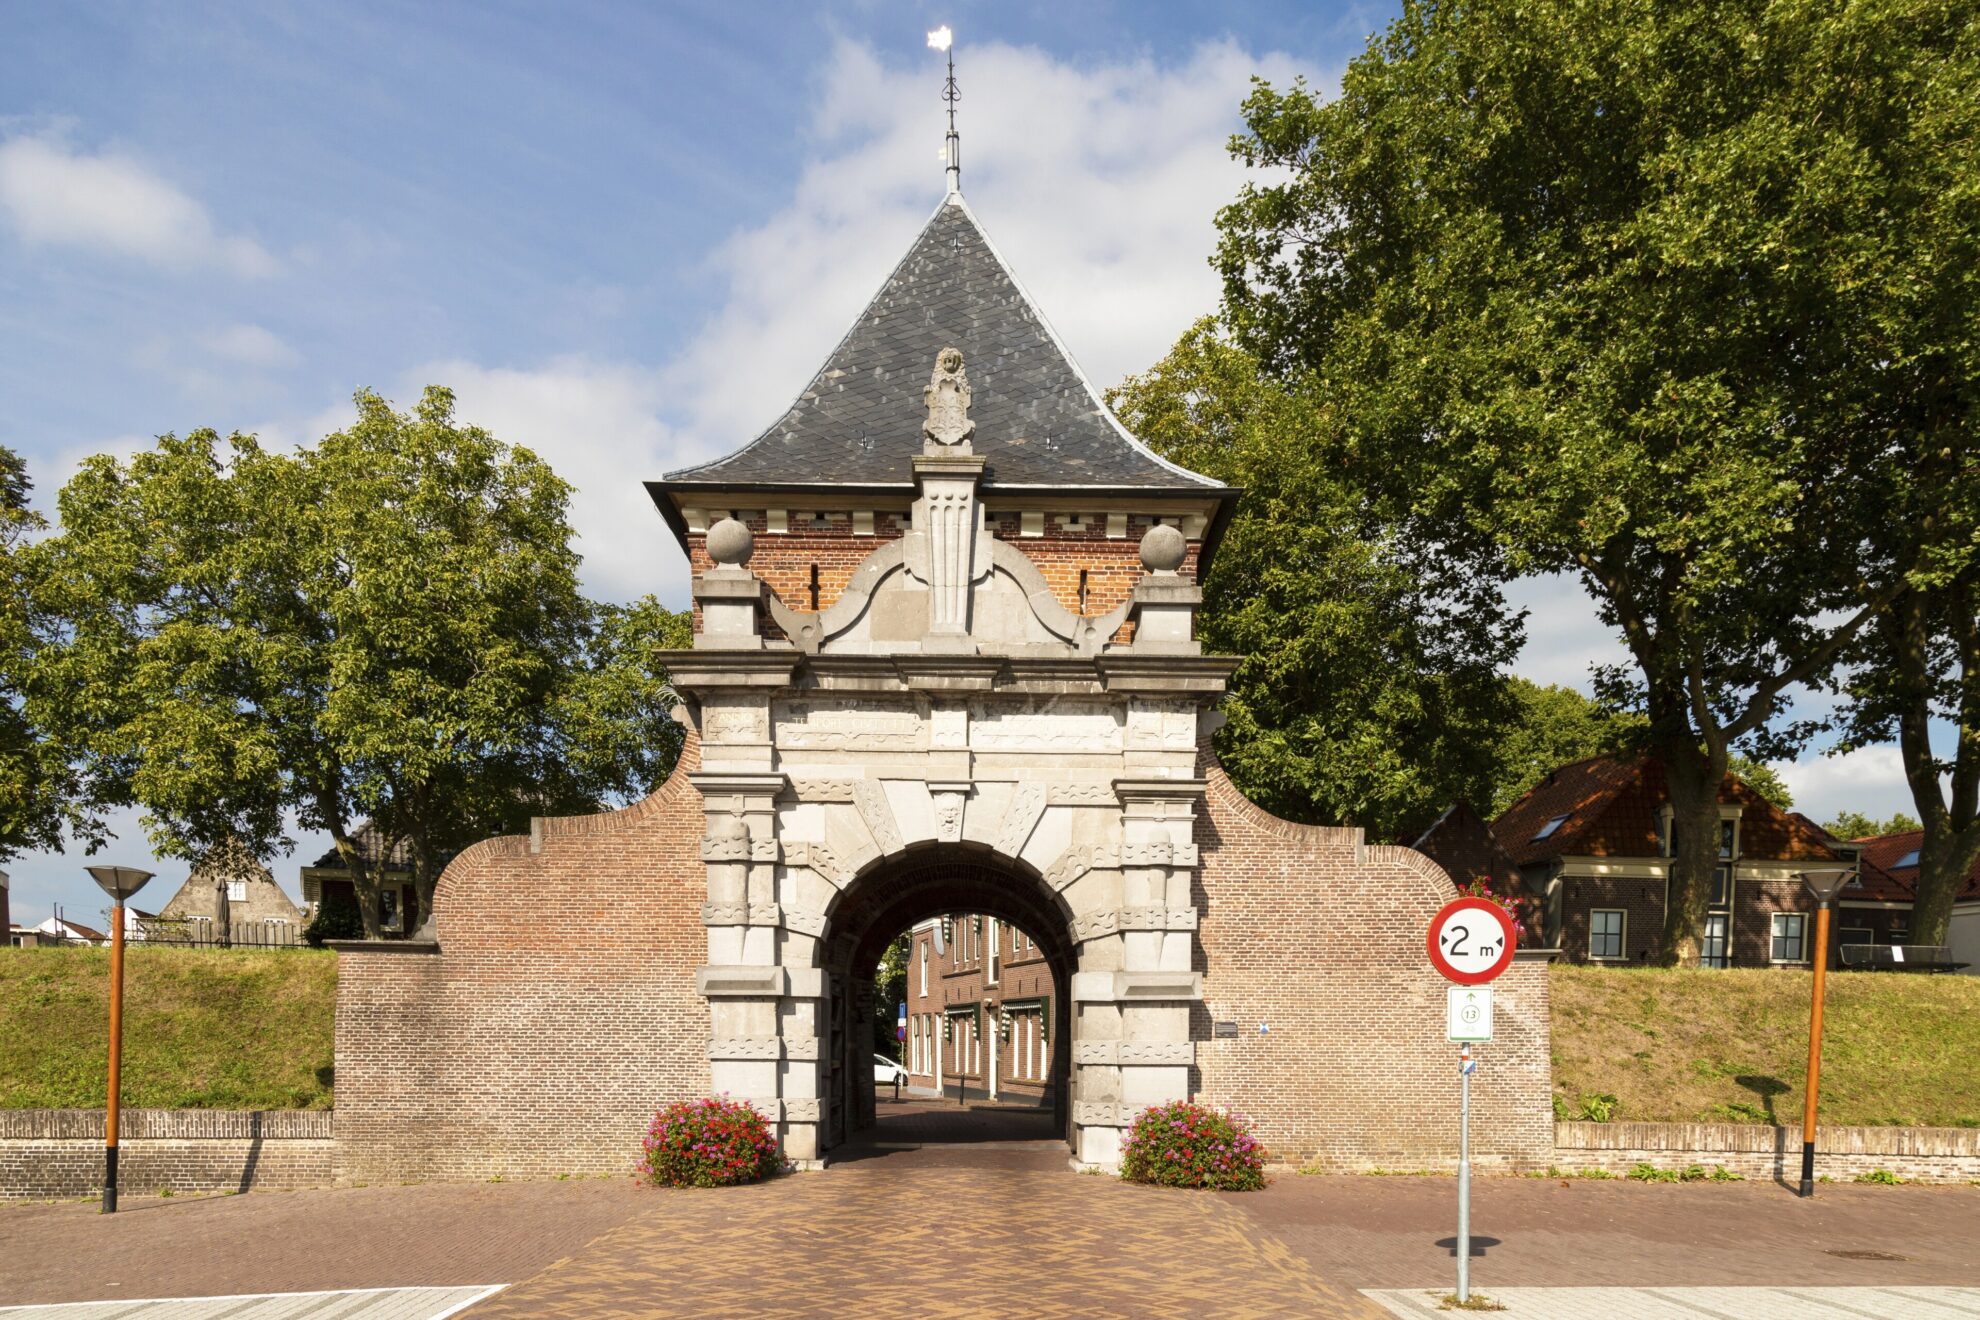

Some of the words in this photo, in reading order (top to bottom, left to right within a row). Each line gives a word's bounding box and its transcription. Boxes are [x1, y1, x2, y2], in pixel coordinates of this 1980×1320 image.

[1450, 926, 1469, 956] 2
[1480, 946, 1494, 957] m
[1465, 1010, 1477, 1019] 13
